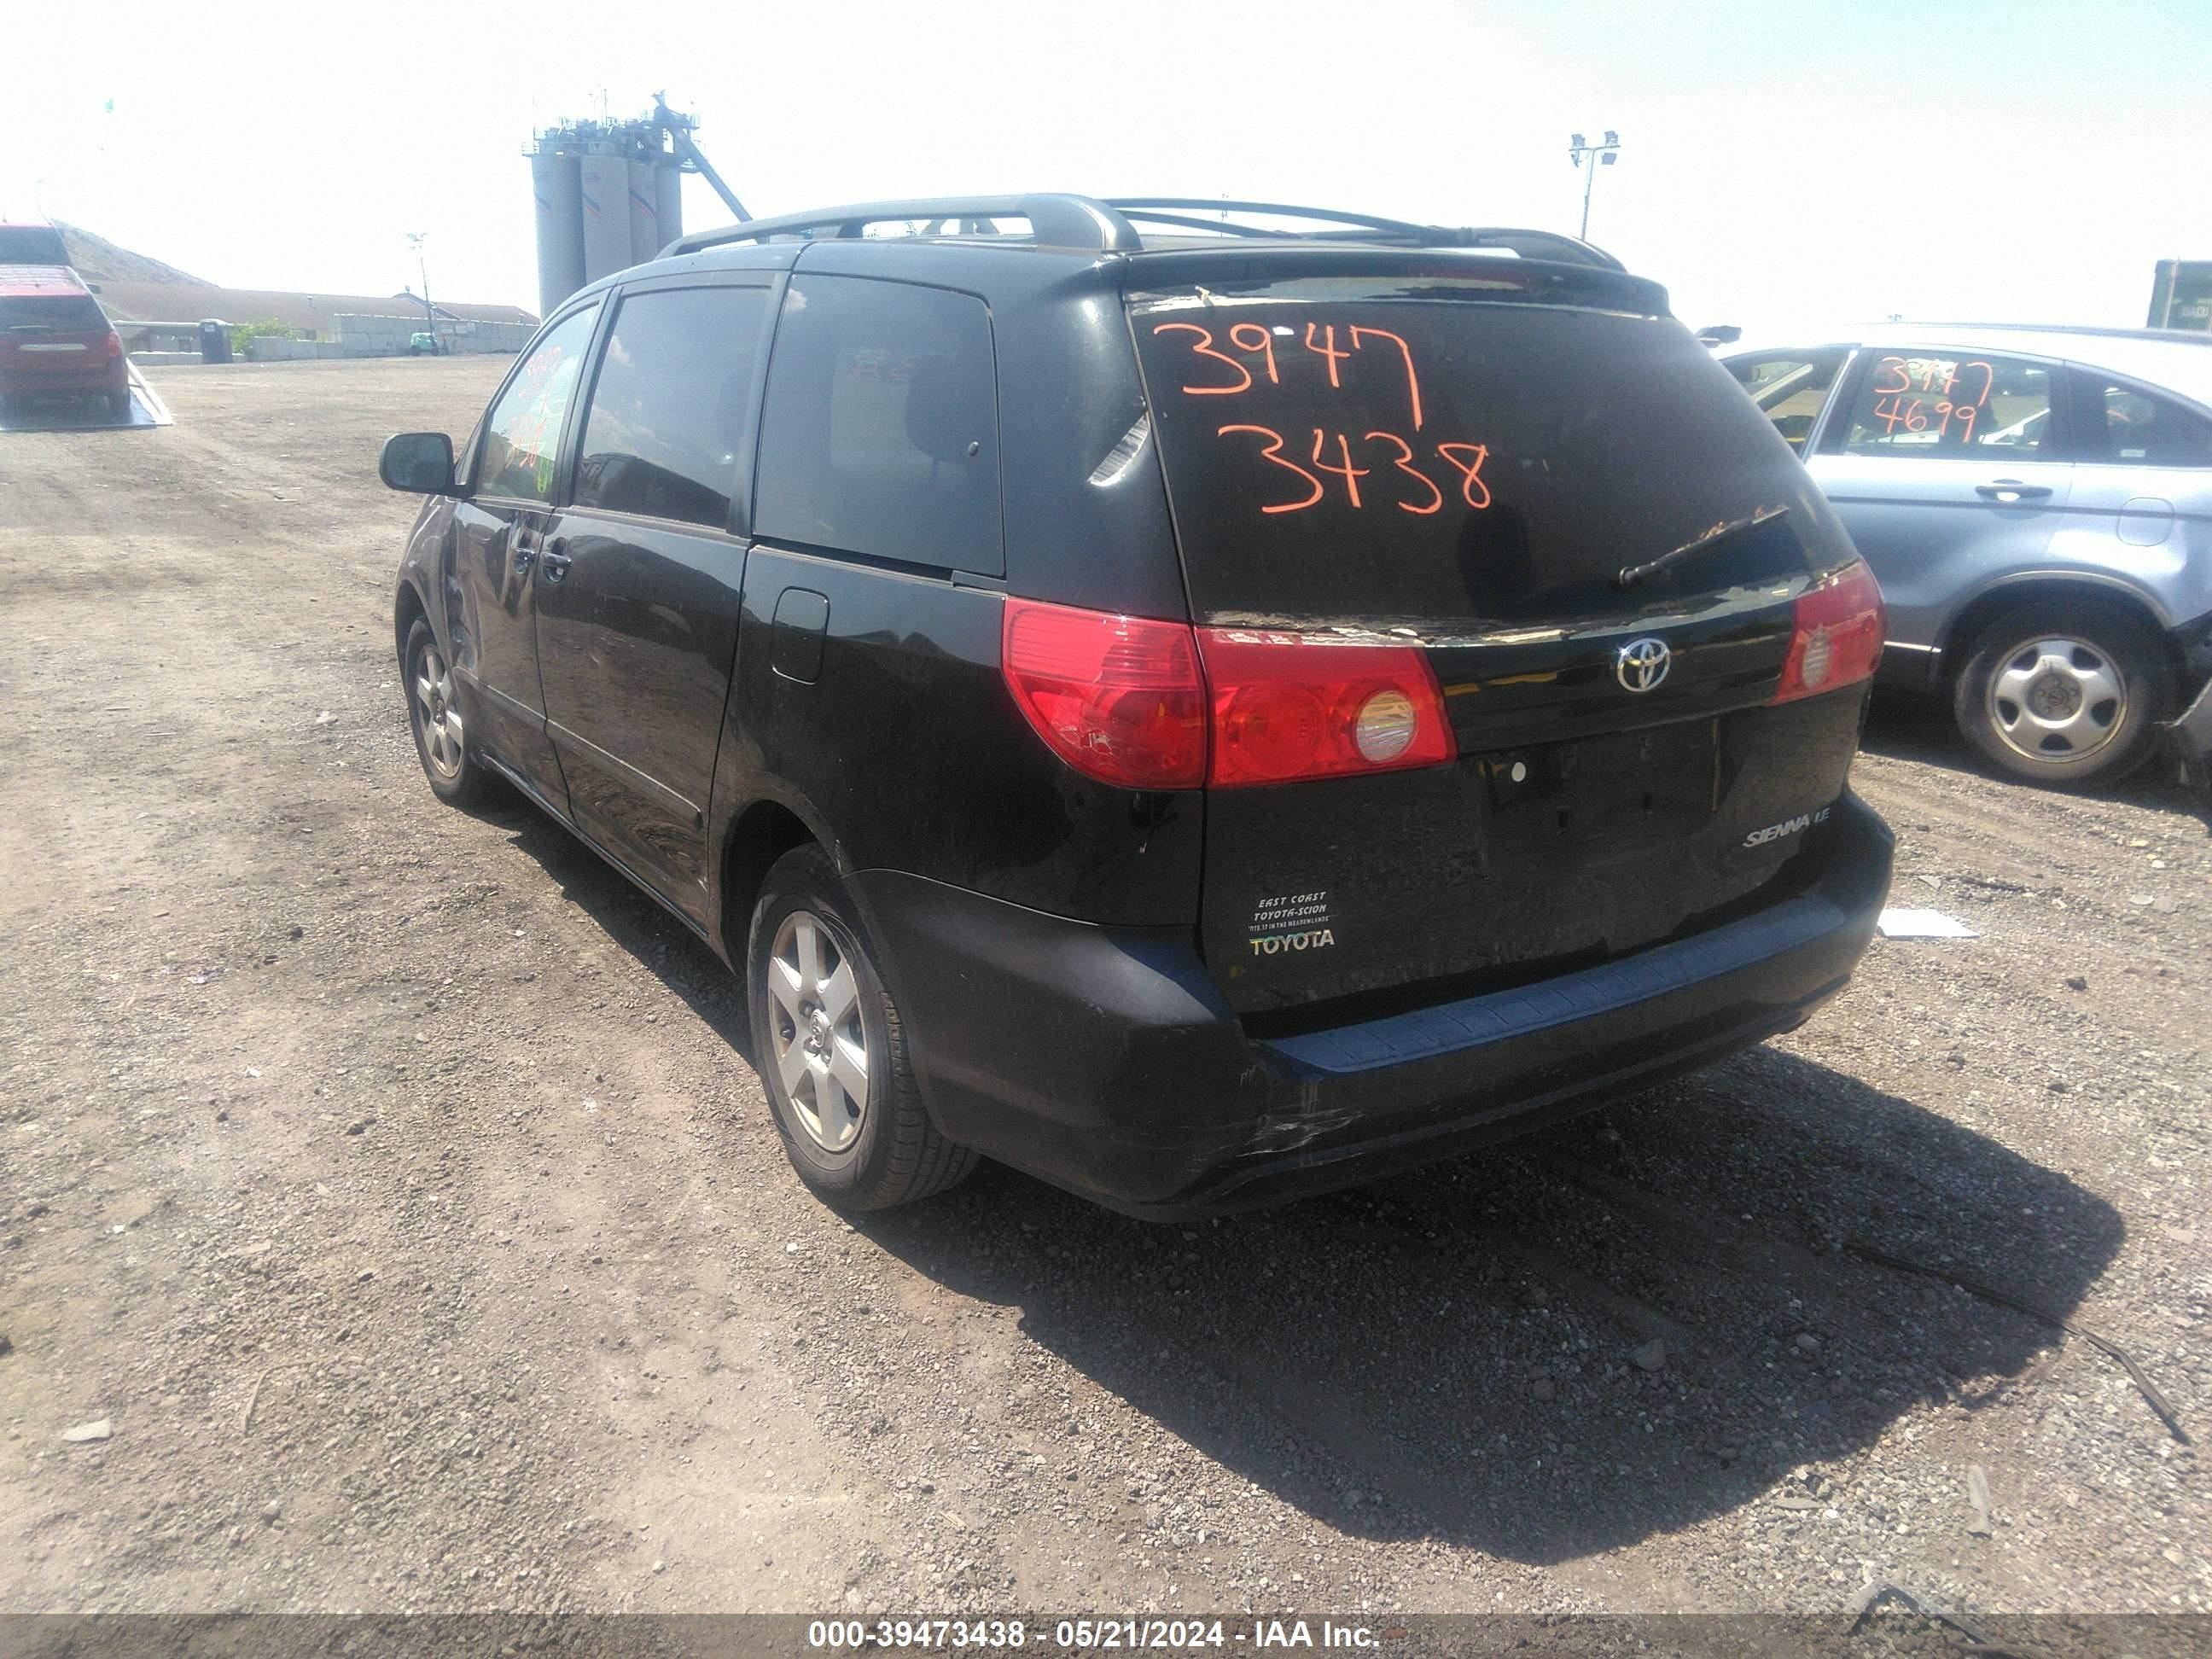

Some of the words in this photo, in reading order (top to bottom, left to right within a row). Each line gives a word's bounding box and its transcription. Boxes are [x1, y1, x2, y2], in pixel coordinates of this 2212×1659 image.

[1154, 323, 1423, 432] 3947
[1874, 356, 1994, 407] 3947
[1874, 397, 1977, 443] 4699
[1218, 423, 1492, 514] 3438
[1742, 813, 1810, 847] SIENNA
[1814, 807, 1831, 824] LE
[1254, 904, 1327, 922] TOYOTA-SCION
[1258, 896, 1287, 908] EAST
[1290, 891, 1327, 904] COAST
[1249, 928, 1336, 956] TOYOTA
